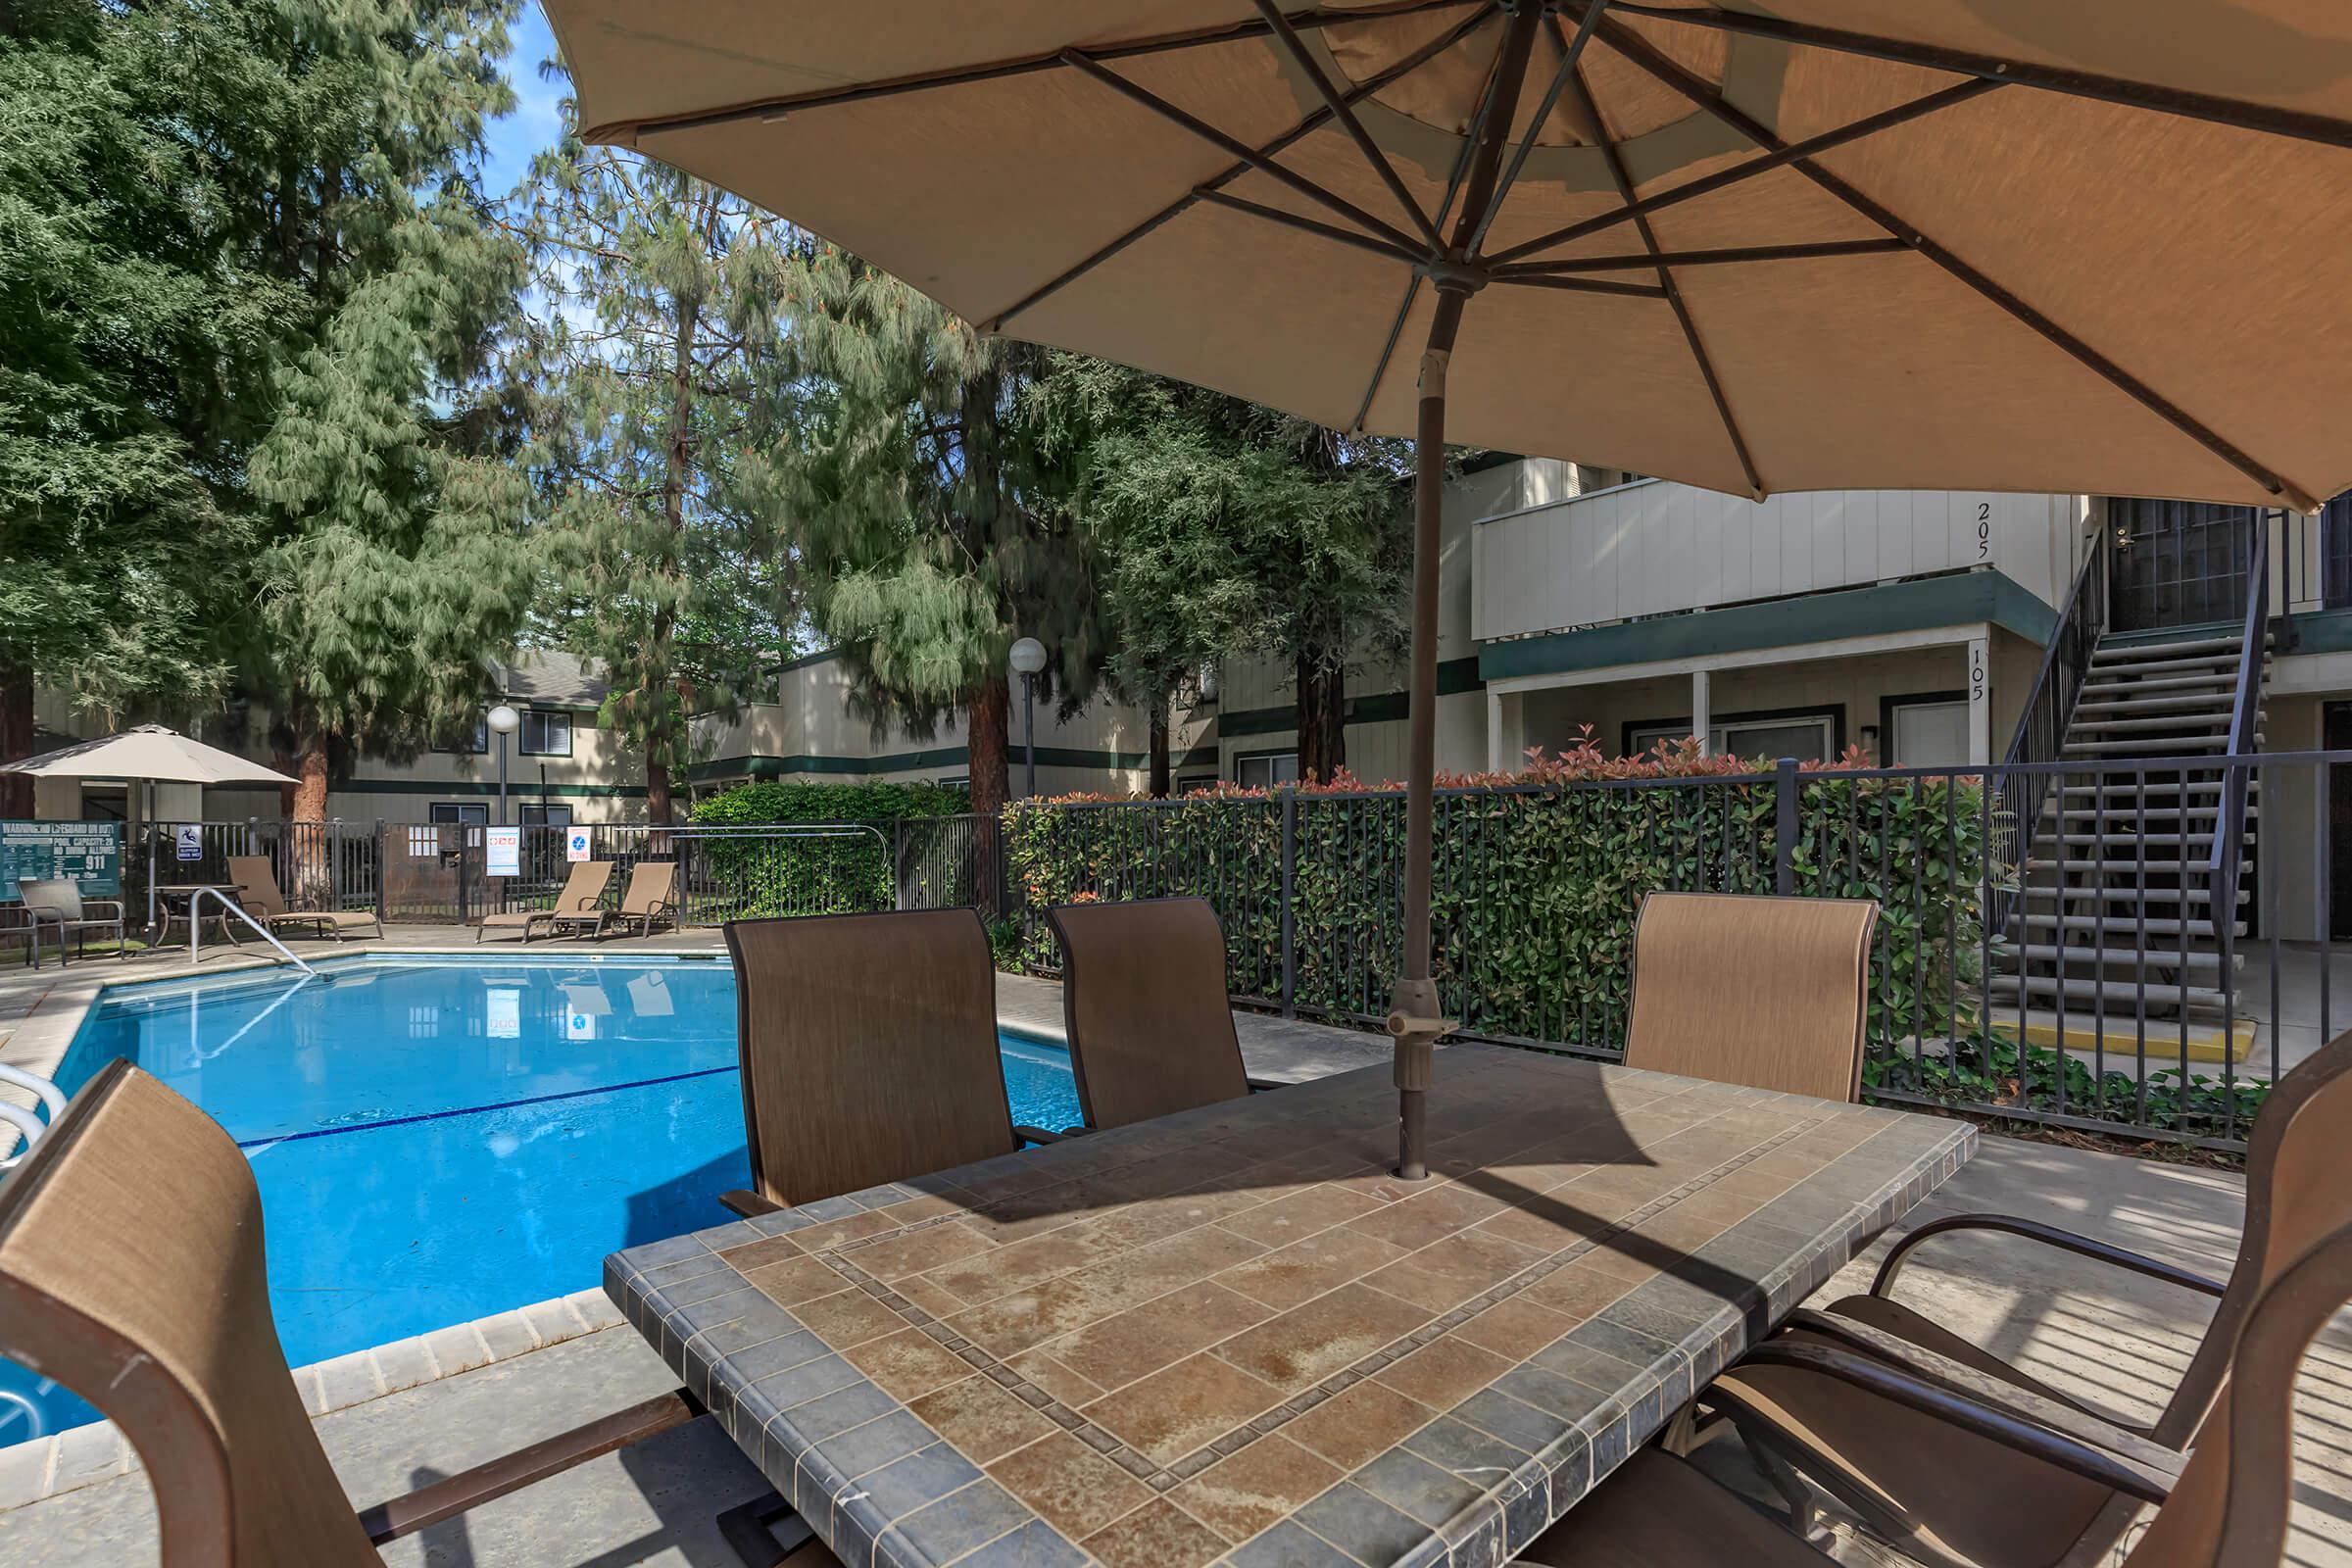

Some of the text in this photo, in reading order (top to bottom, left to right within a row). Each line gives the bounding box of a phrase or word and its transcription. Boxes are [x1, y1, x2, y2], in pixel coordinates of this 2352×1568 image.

[1978, 502, 1989, 559] 205
[1972, 649, 1984, 701] 105
[85, 856, 105, 869] 911
